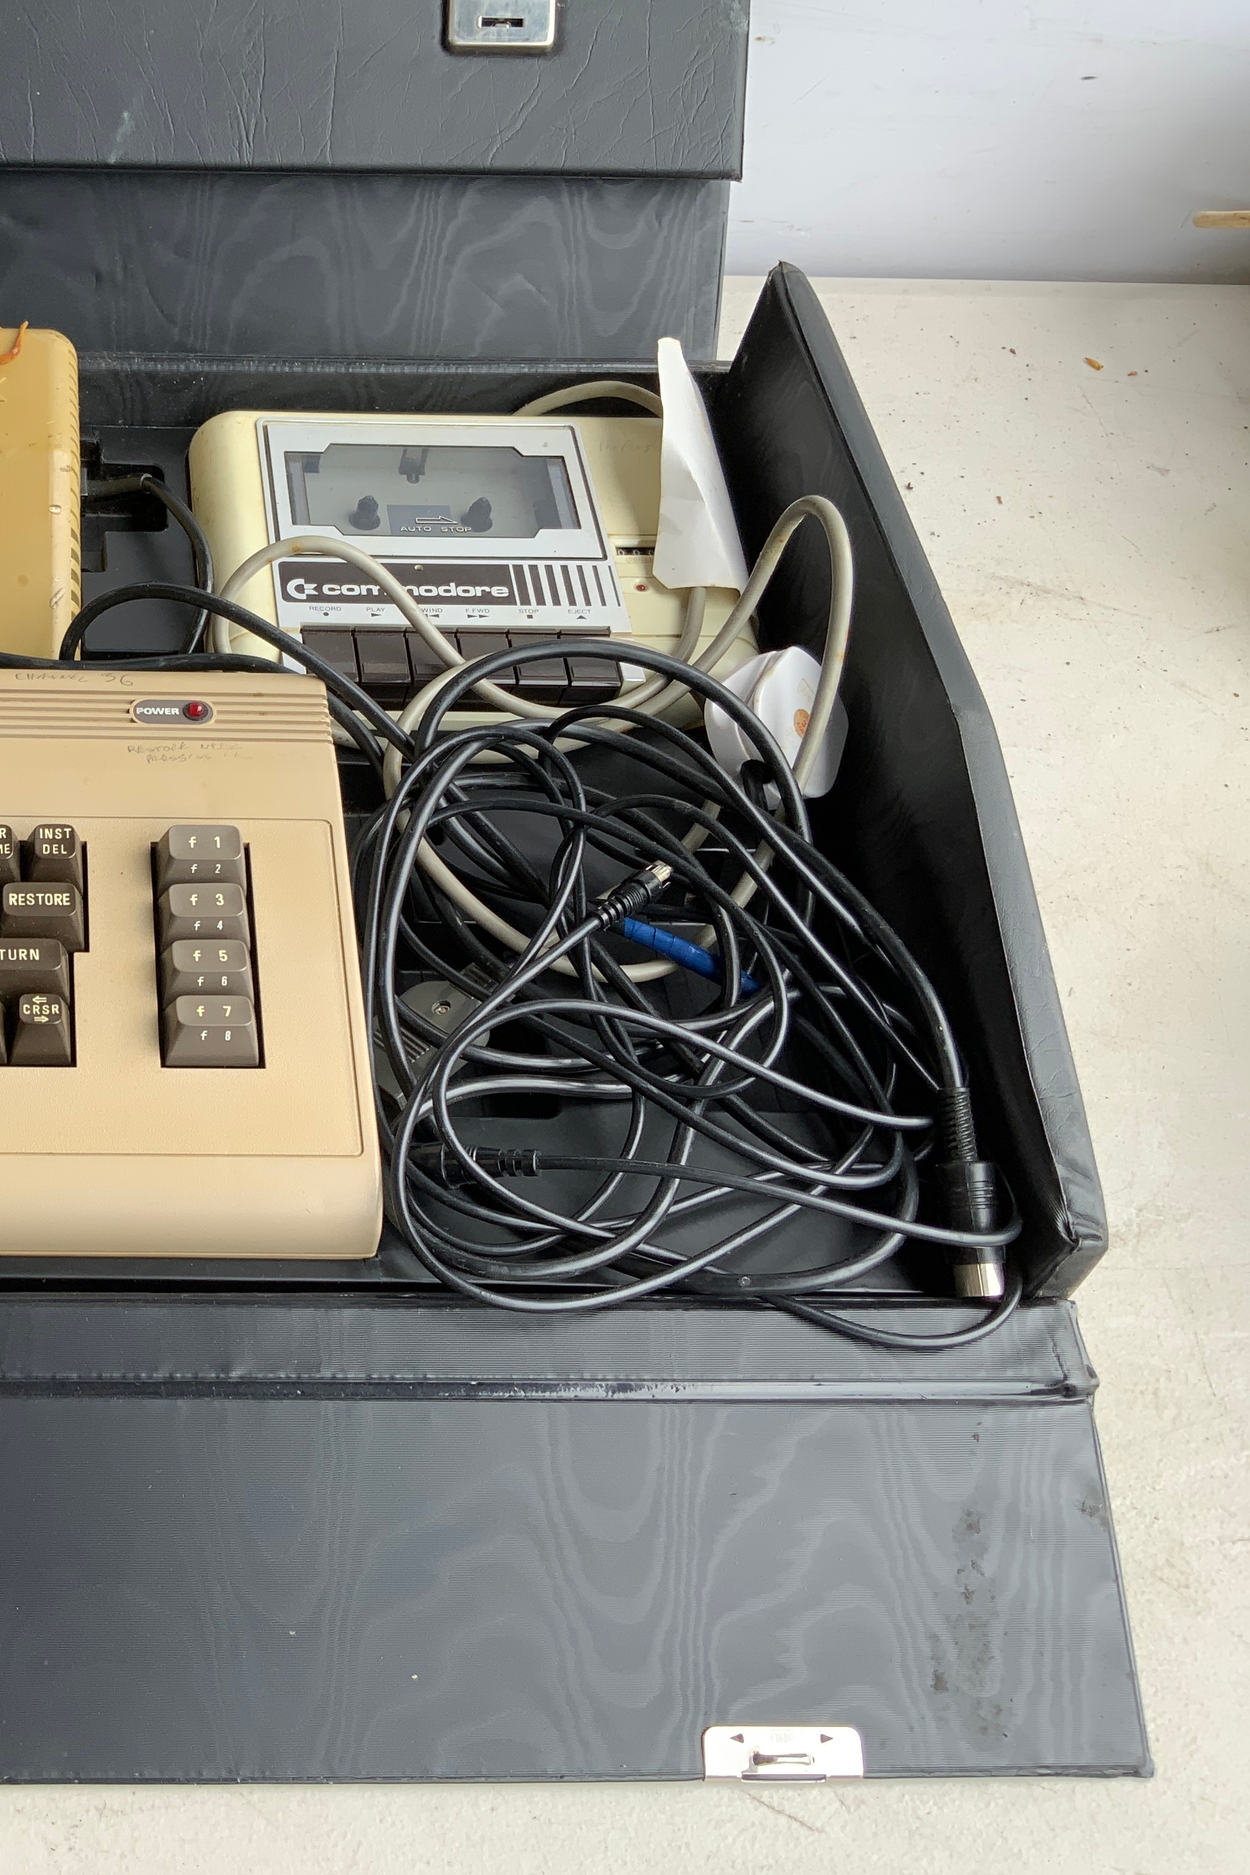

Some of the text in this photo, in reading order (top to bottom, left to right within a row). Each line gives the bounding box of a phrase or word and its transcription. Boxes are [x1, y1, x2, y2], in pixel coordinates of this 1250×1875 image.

[101, 672, 134, 687] 36
[136, 706, 180, 716] POWER
[39, 828, 71, 840] INST
[42, 843, 67, 855] DEL
[8, 893, 71, 906] RESTORE
[22, 1004, 60, 1016] CRSR
